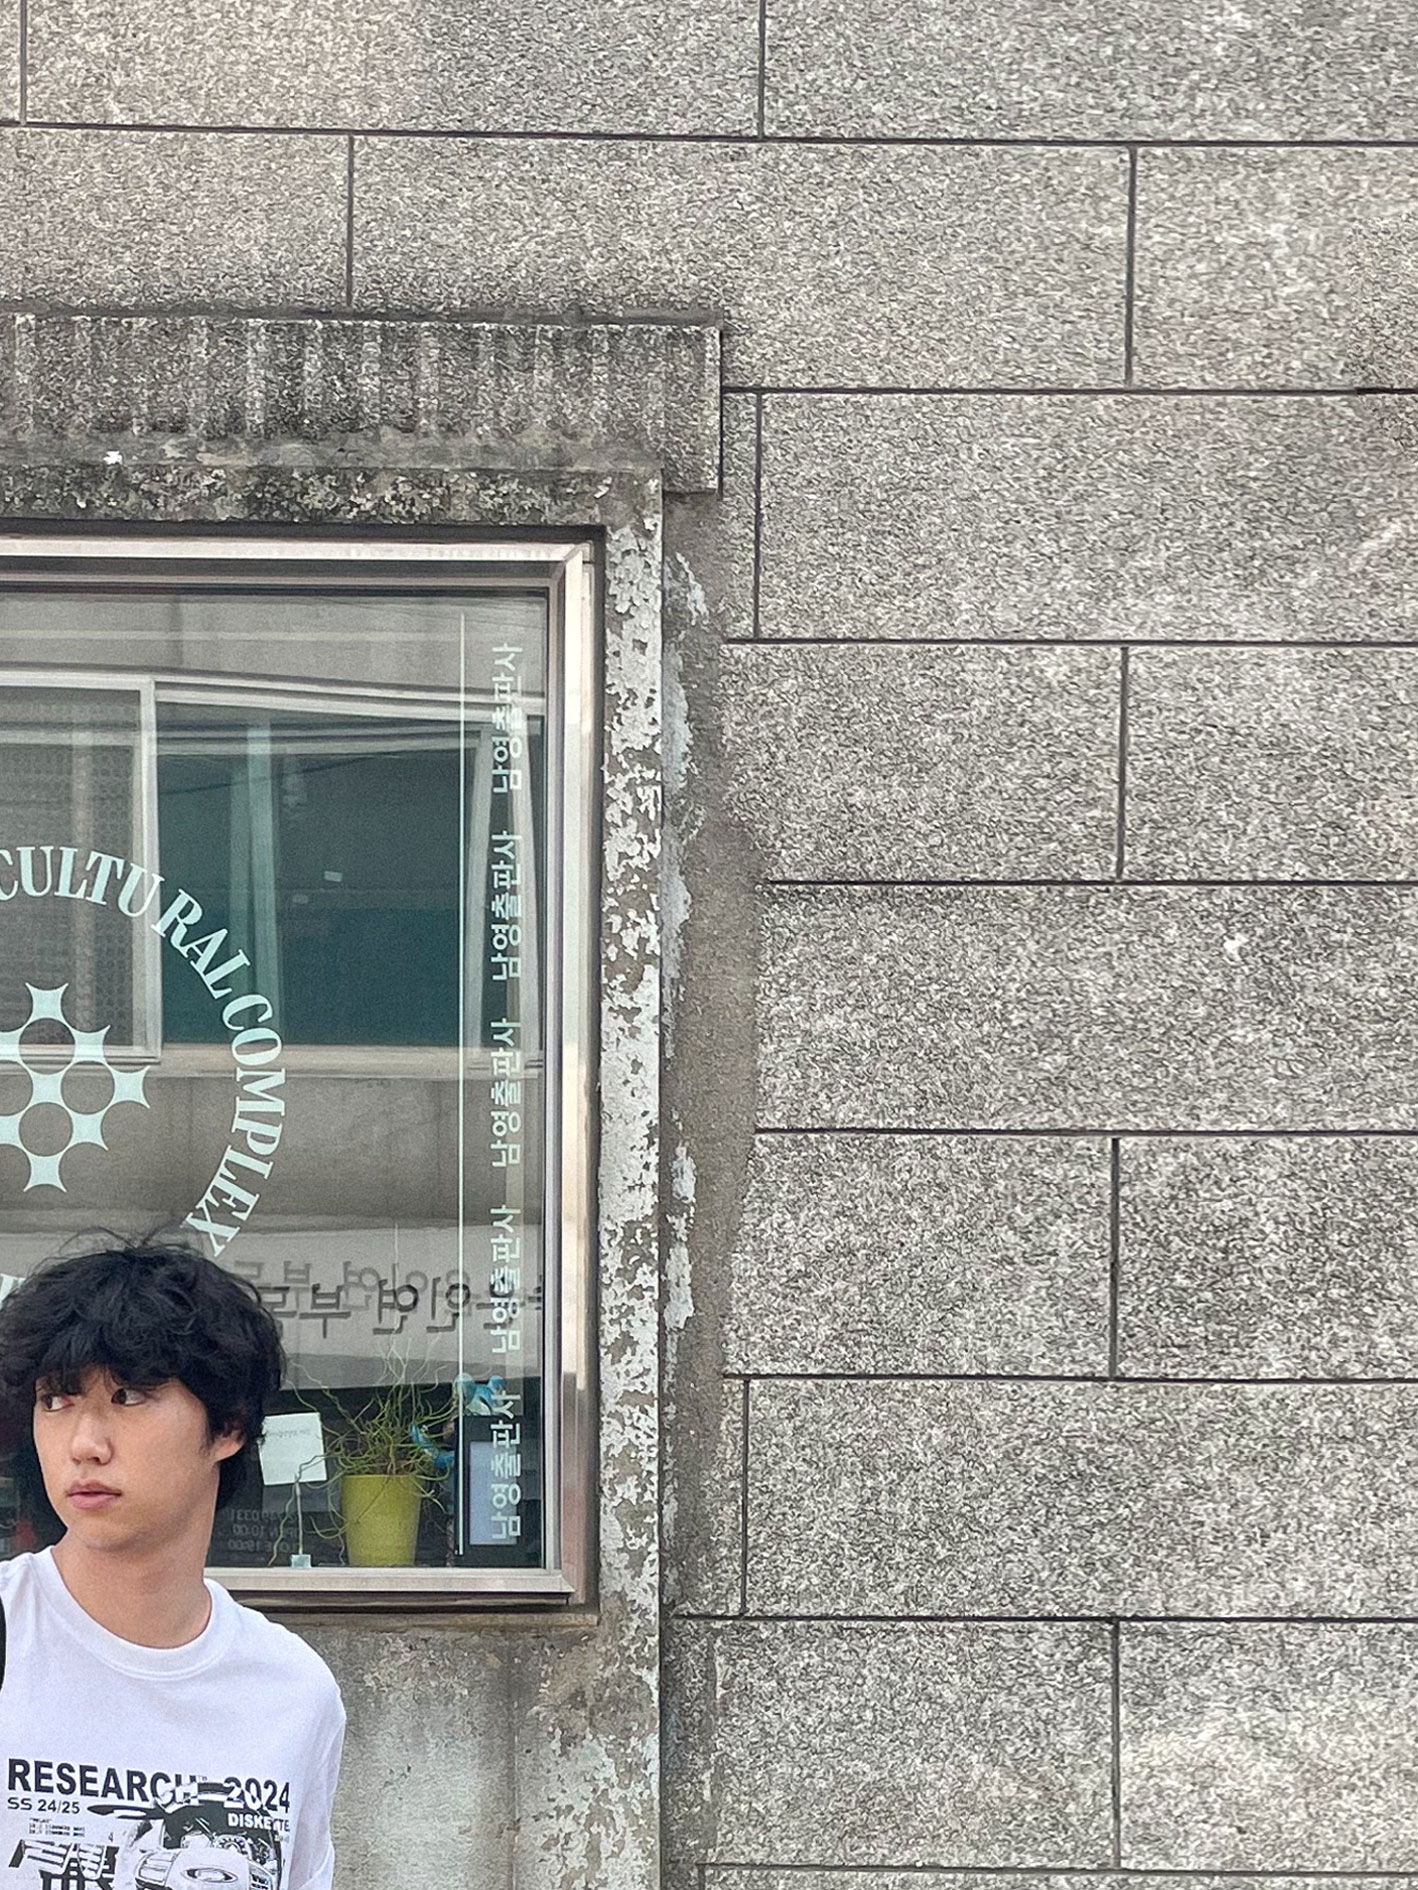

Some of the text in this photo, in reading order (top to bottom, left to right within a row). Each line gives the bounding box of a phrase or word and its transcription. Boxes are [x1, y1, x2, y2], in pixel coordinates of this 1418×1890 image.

[491, 830, 523, 982] 남영출판사
[180, 992, 286, 1258] COMPLEX
[490, 1017, 522, 1168] 남영출판사
[7, 1796, 81, 1815] SS 24/25
[224, 1776, 291, 1814] 2024
